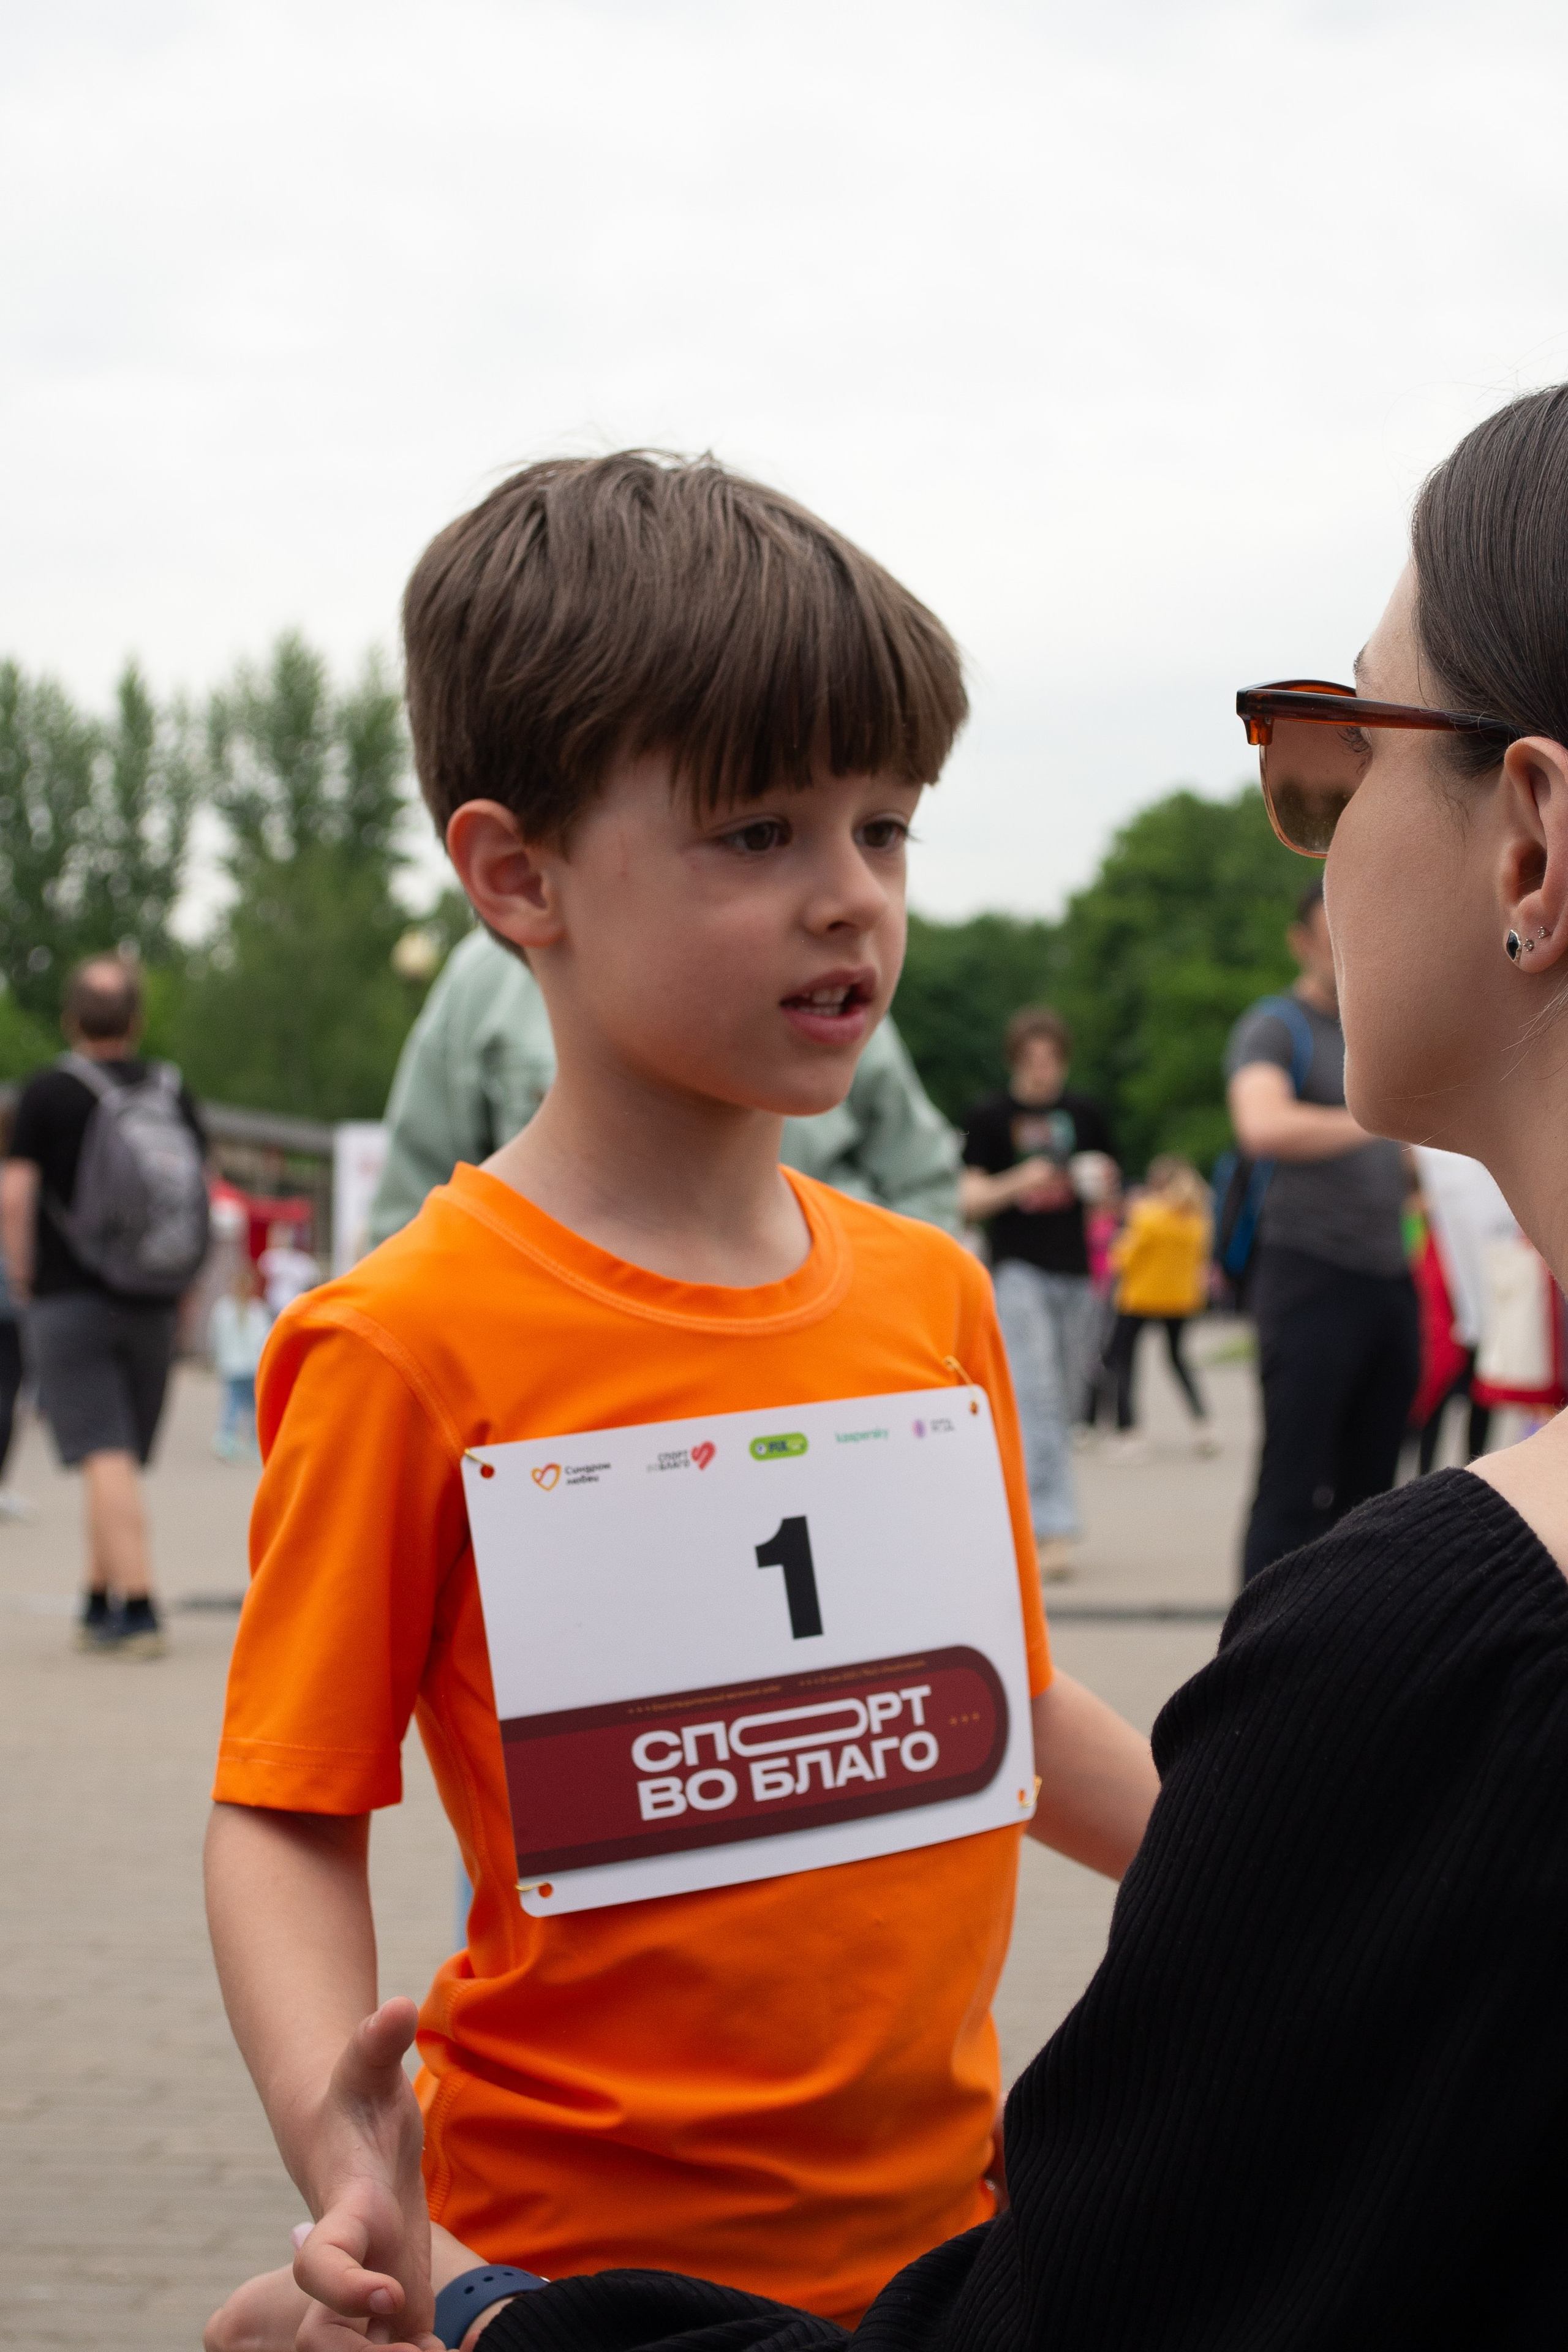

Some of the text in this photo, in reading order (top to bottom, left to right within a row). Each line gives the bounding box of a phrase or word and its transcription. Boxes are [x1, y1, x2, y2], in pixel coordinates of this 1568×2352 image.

[754, 1515, 824, 1640] 1
[631, 1684, 932, 1773] СПОРТ
[637, 1730, 939, 1821] ВО БЛАГО
